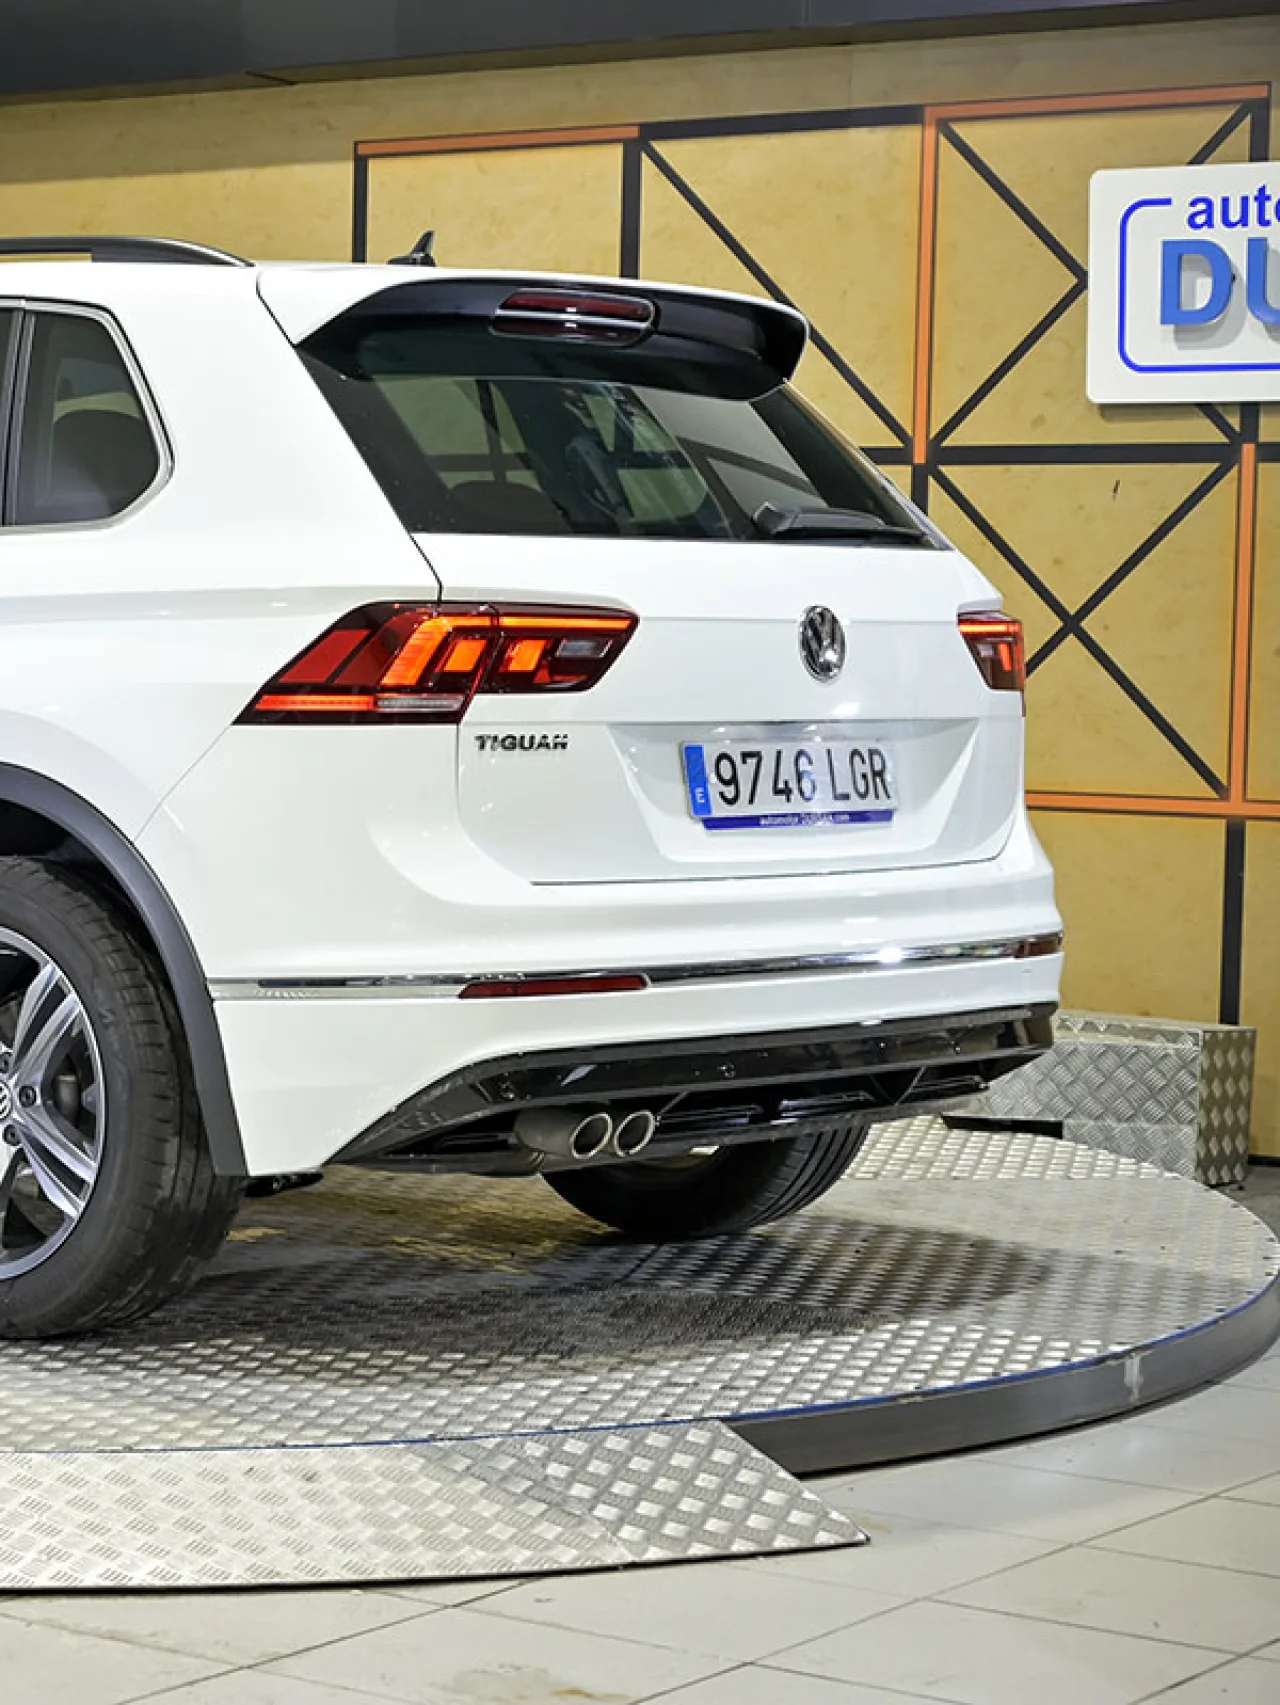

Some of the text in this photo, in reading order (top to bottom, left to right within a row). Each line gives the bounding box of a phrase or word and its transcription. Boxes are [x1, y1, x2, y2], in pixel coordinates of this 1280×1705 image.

[1187, 184, 1280, 229] aut
[474, 733, 568, 751] TIGUAN
[714, 747, 892, 806] 9746 LGR
[694, 786, 706, 804] E
